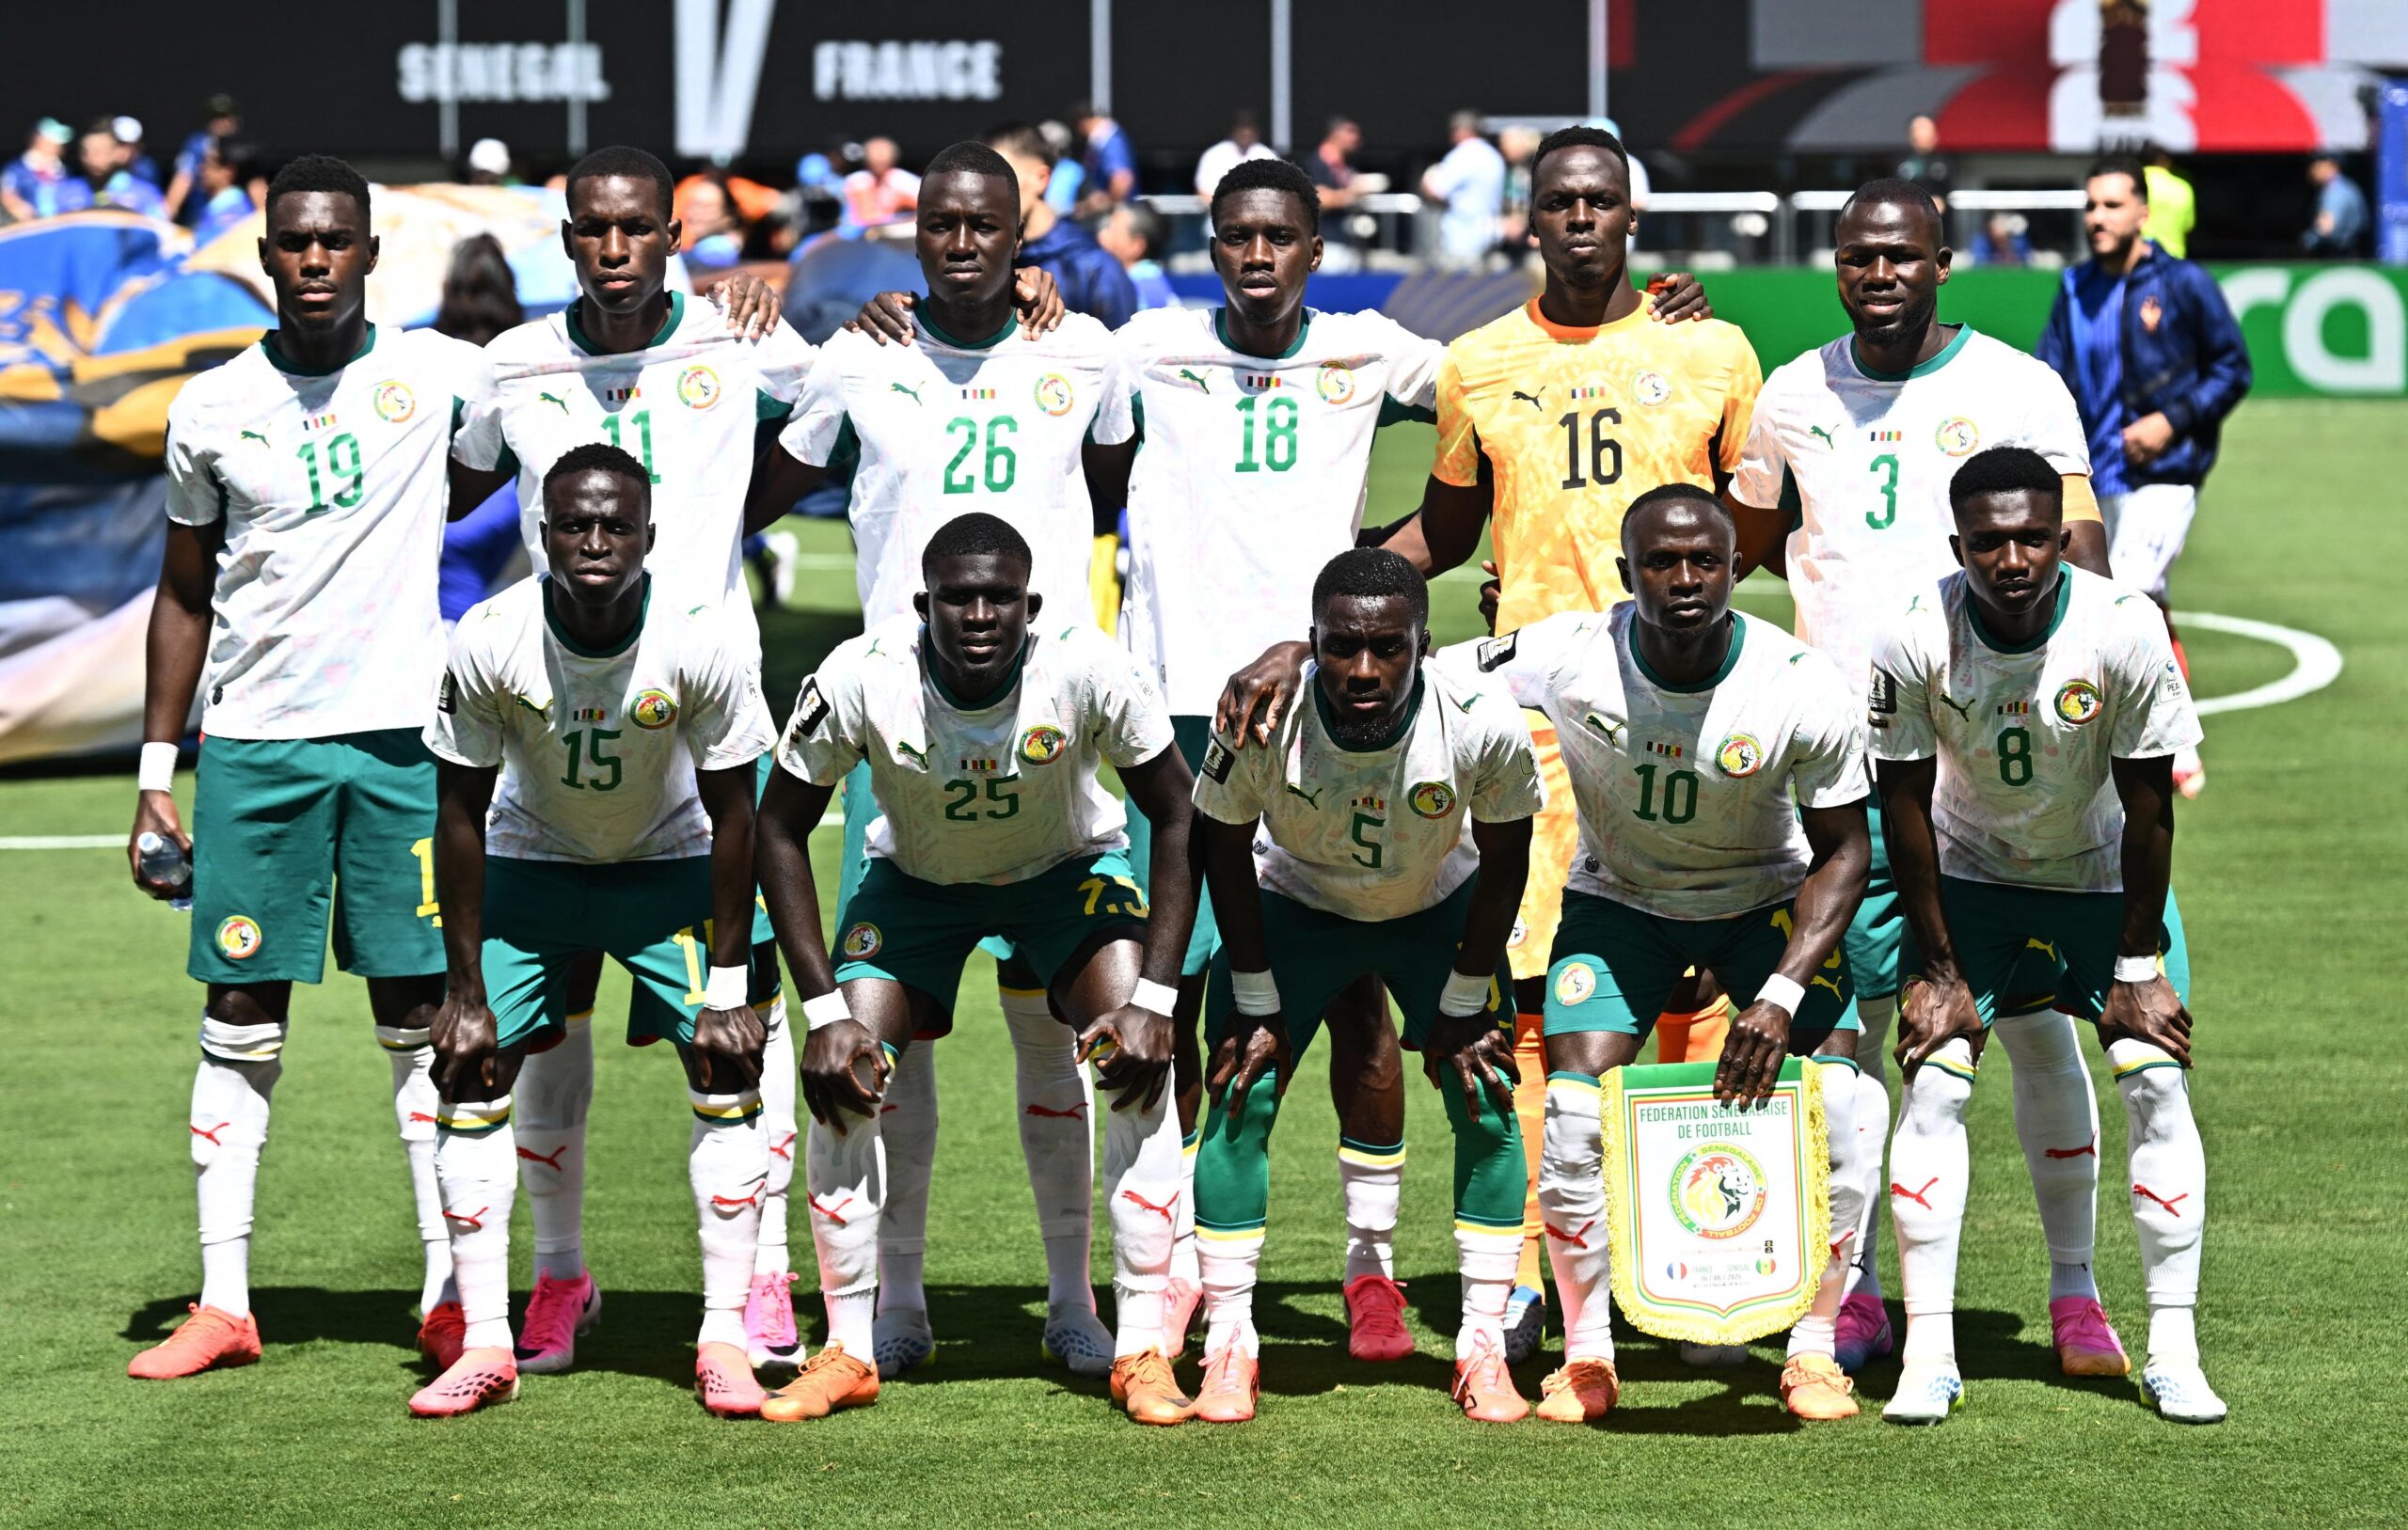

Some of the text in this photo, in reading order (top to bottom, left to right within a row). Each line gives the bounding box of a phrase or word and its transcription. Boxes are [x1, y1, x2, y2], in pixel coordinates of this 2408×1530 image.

[397, 43, 610, 102] SENEGAL
[813, 41, 1003, 101] FRANCE
[601, 410, 661, 484] 11
[943, 416, 1019, 495] 26
[1235, 396, 1298, 473] 18
[1559, 408, 1624, 490] 16
[297, 433, 363, 514] 19
[1865, 453, 1900, 530] 3
[562, 728, 623, 791] 15
[1997, 727, 2034, 787] 8
[944, 775, 1019, 821] 25
[1633, 764, 1699, 825] 10
[1352, 812, 1386, 868] 5
[1678, 1122, 1752, 1139] DE FOOTBALL
